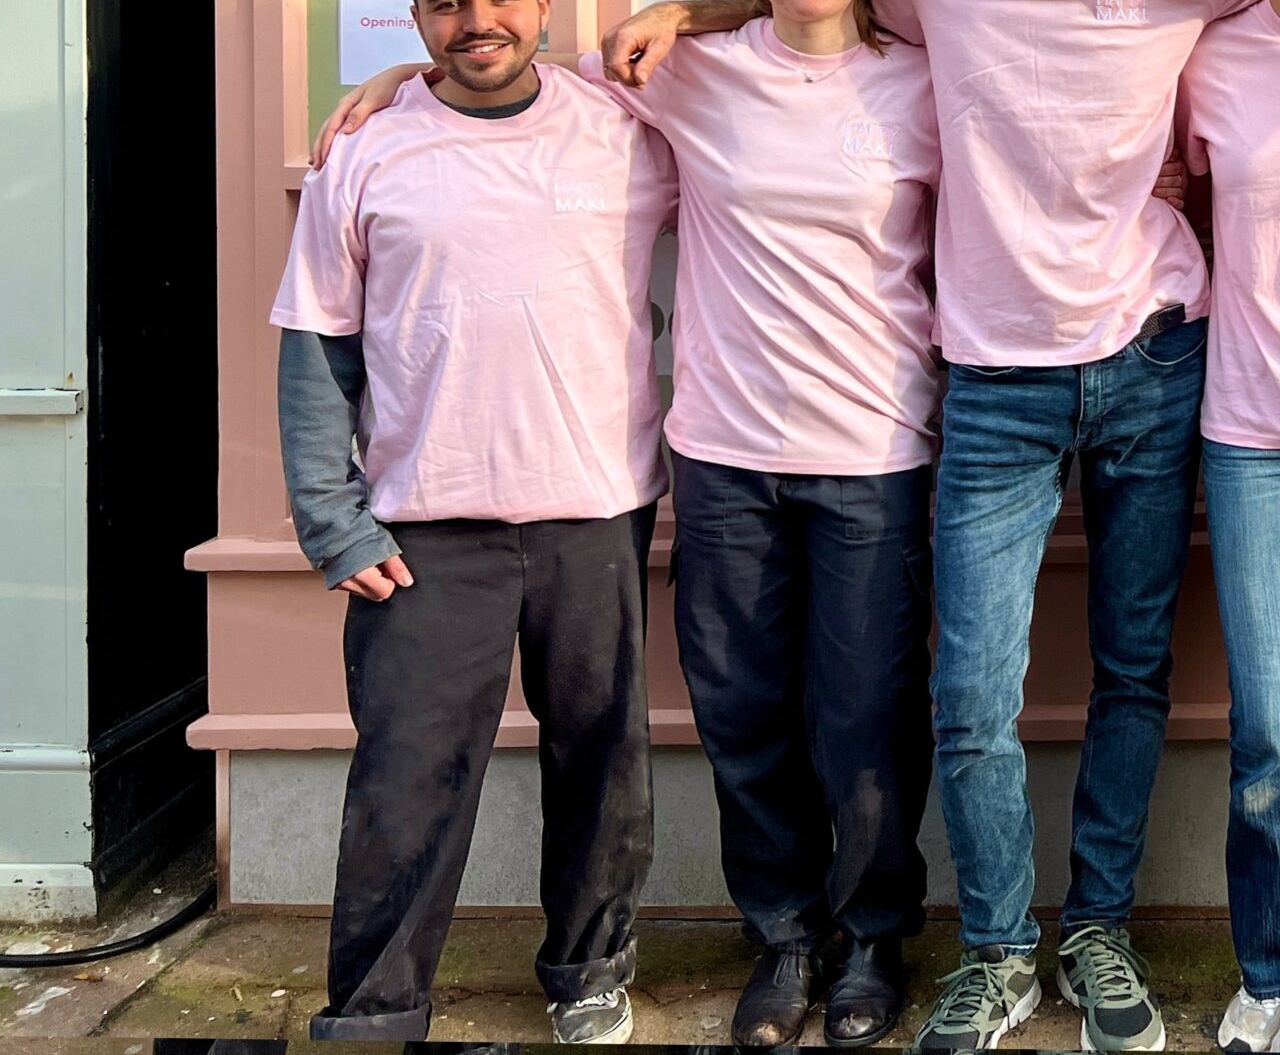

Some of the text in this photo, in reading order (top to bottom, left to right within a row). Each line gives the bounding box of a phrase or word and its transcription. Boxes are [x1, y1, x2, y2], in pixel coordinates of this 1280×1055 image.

[1095, 6, 1147, 22] MAKI
[360, 16, 415, 30] Opening
[554, 197, 606, 212] MAKI
